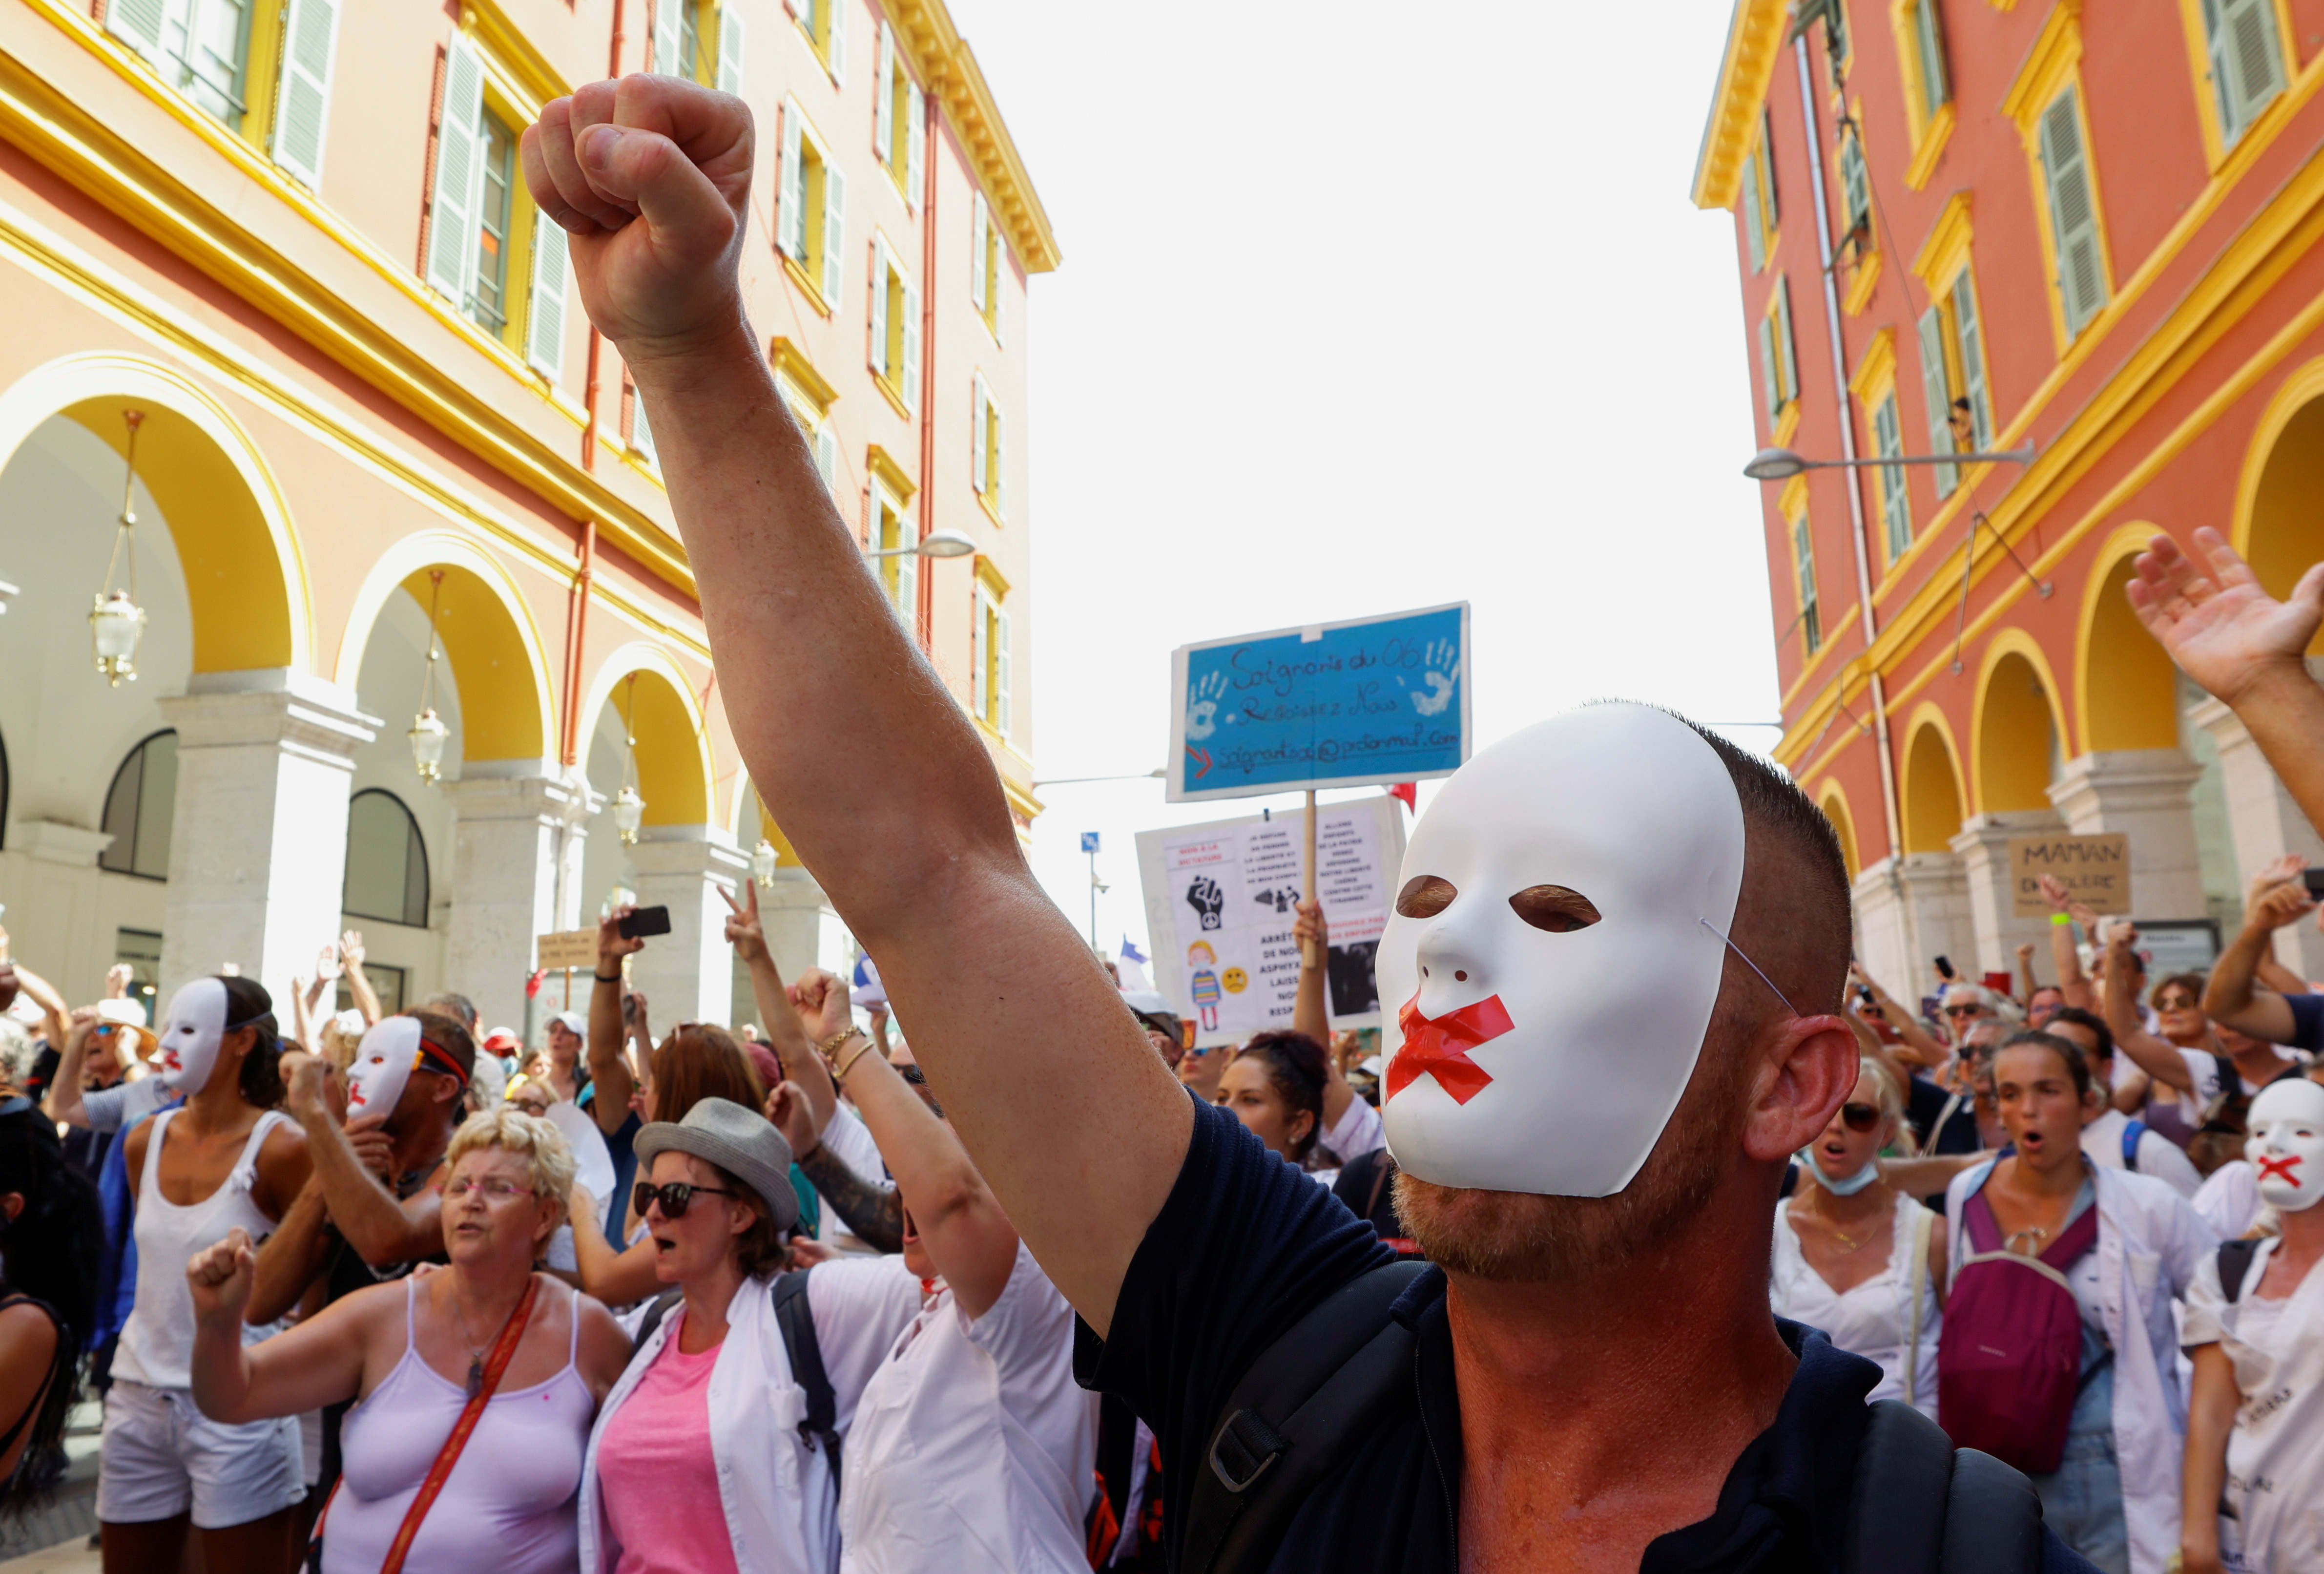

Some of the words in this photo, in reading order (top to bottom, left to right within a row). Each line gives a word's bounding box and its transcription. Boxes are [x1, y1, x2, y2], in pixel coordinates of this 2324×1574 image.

[1349, 648, 1376, 670] du
[1382, 636, 1421, 670] 06
[2024, 842, 2123, 865] MAMAN
[1261, 932, 1293, 944] ARRÊT
[1270, 976, 1299, 987] LAISS
[1278, 992, 1297, 1000] NO
[1270, 1006, 1293, 1016] RESP
